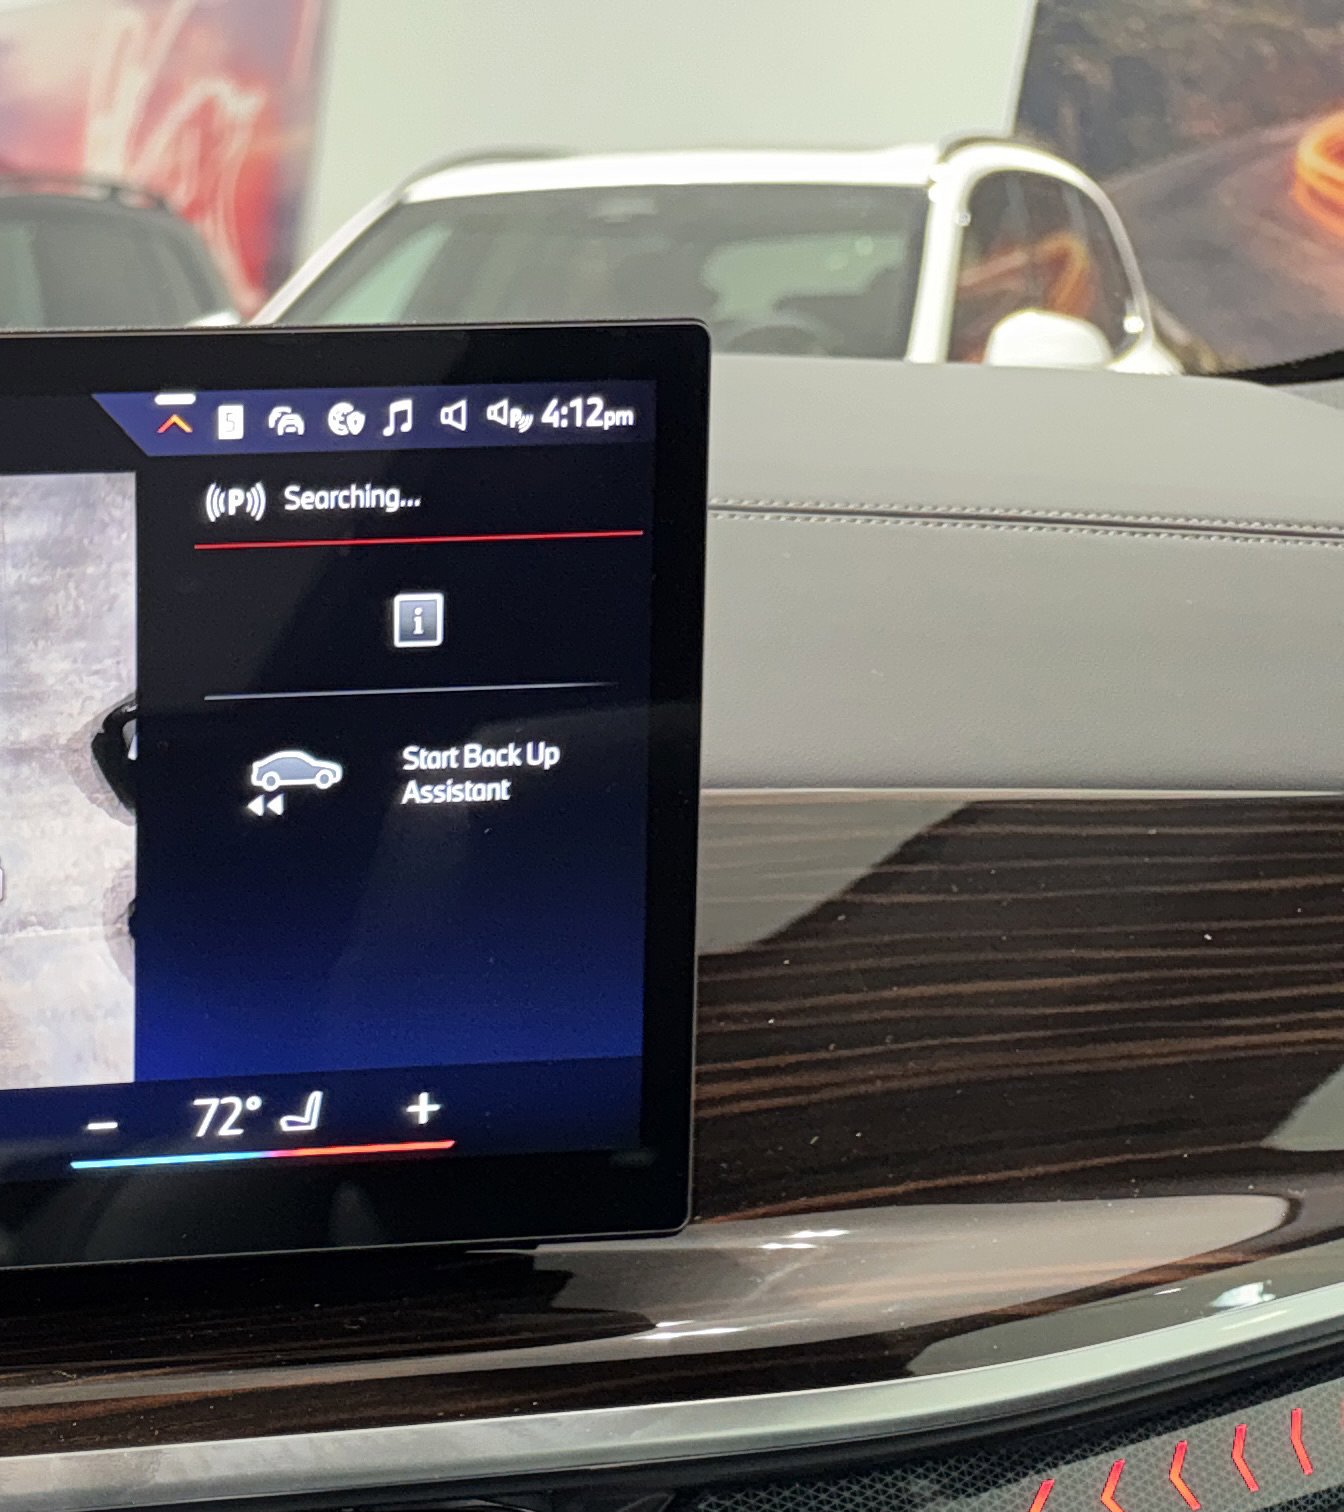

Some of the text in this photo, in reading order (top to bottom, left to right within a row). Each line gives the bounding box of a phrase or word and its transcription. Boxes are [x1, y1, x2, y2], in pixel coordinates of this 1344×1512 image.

[541, 396, 634, 431] 4:12pm
[284, 483, 421, 513] Searching...
[403, 741, 560, 771] Start Back Up
[401, 778, 511, 805] Assistant
[192, 1095, 262, 1137] 72°
